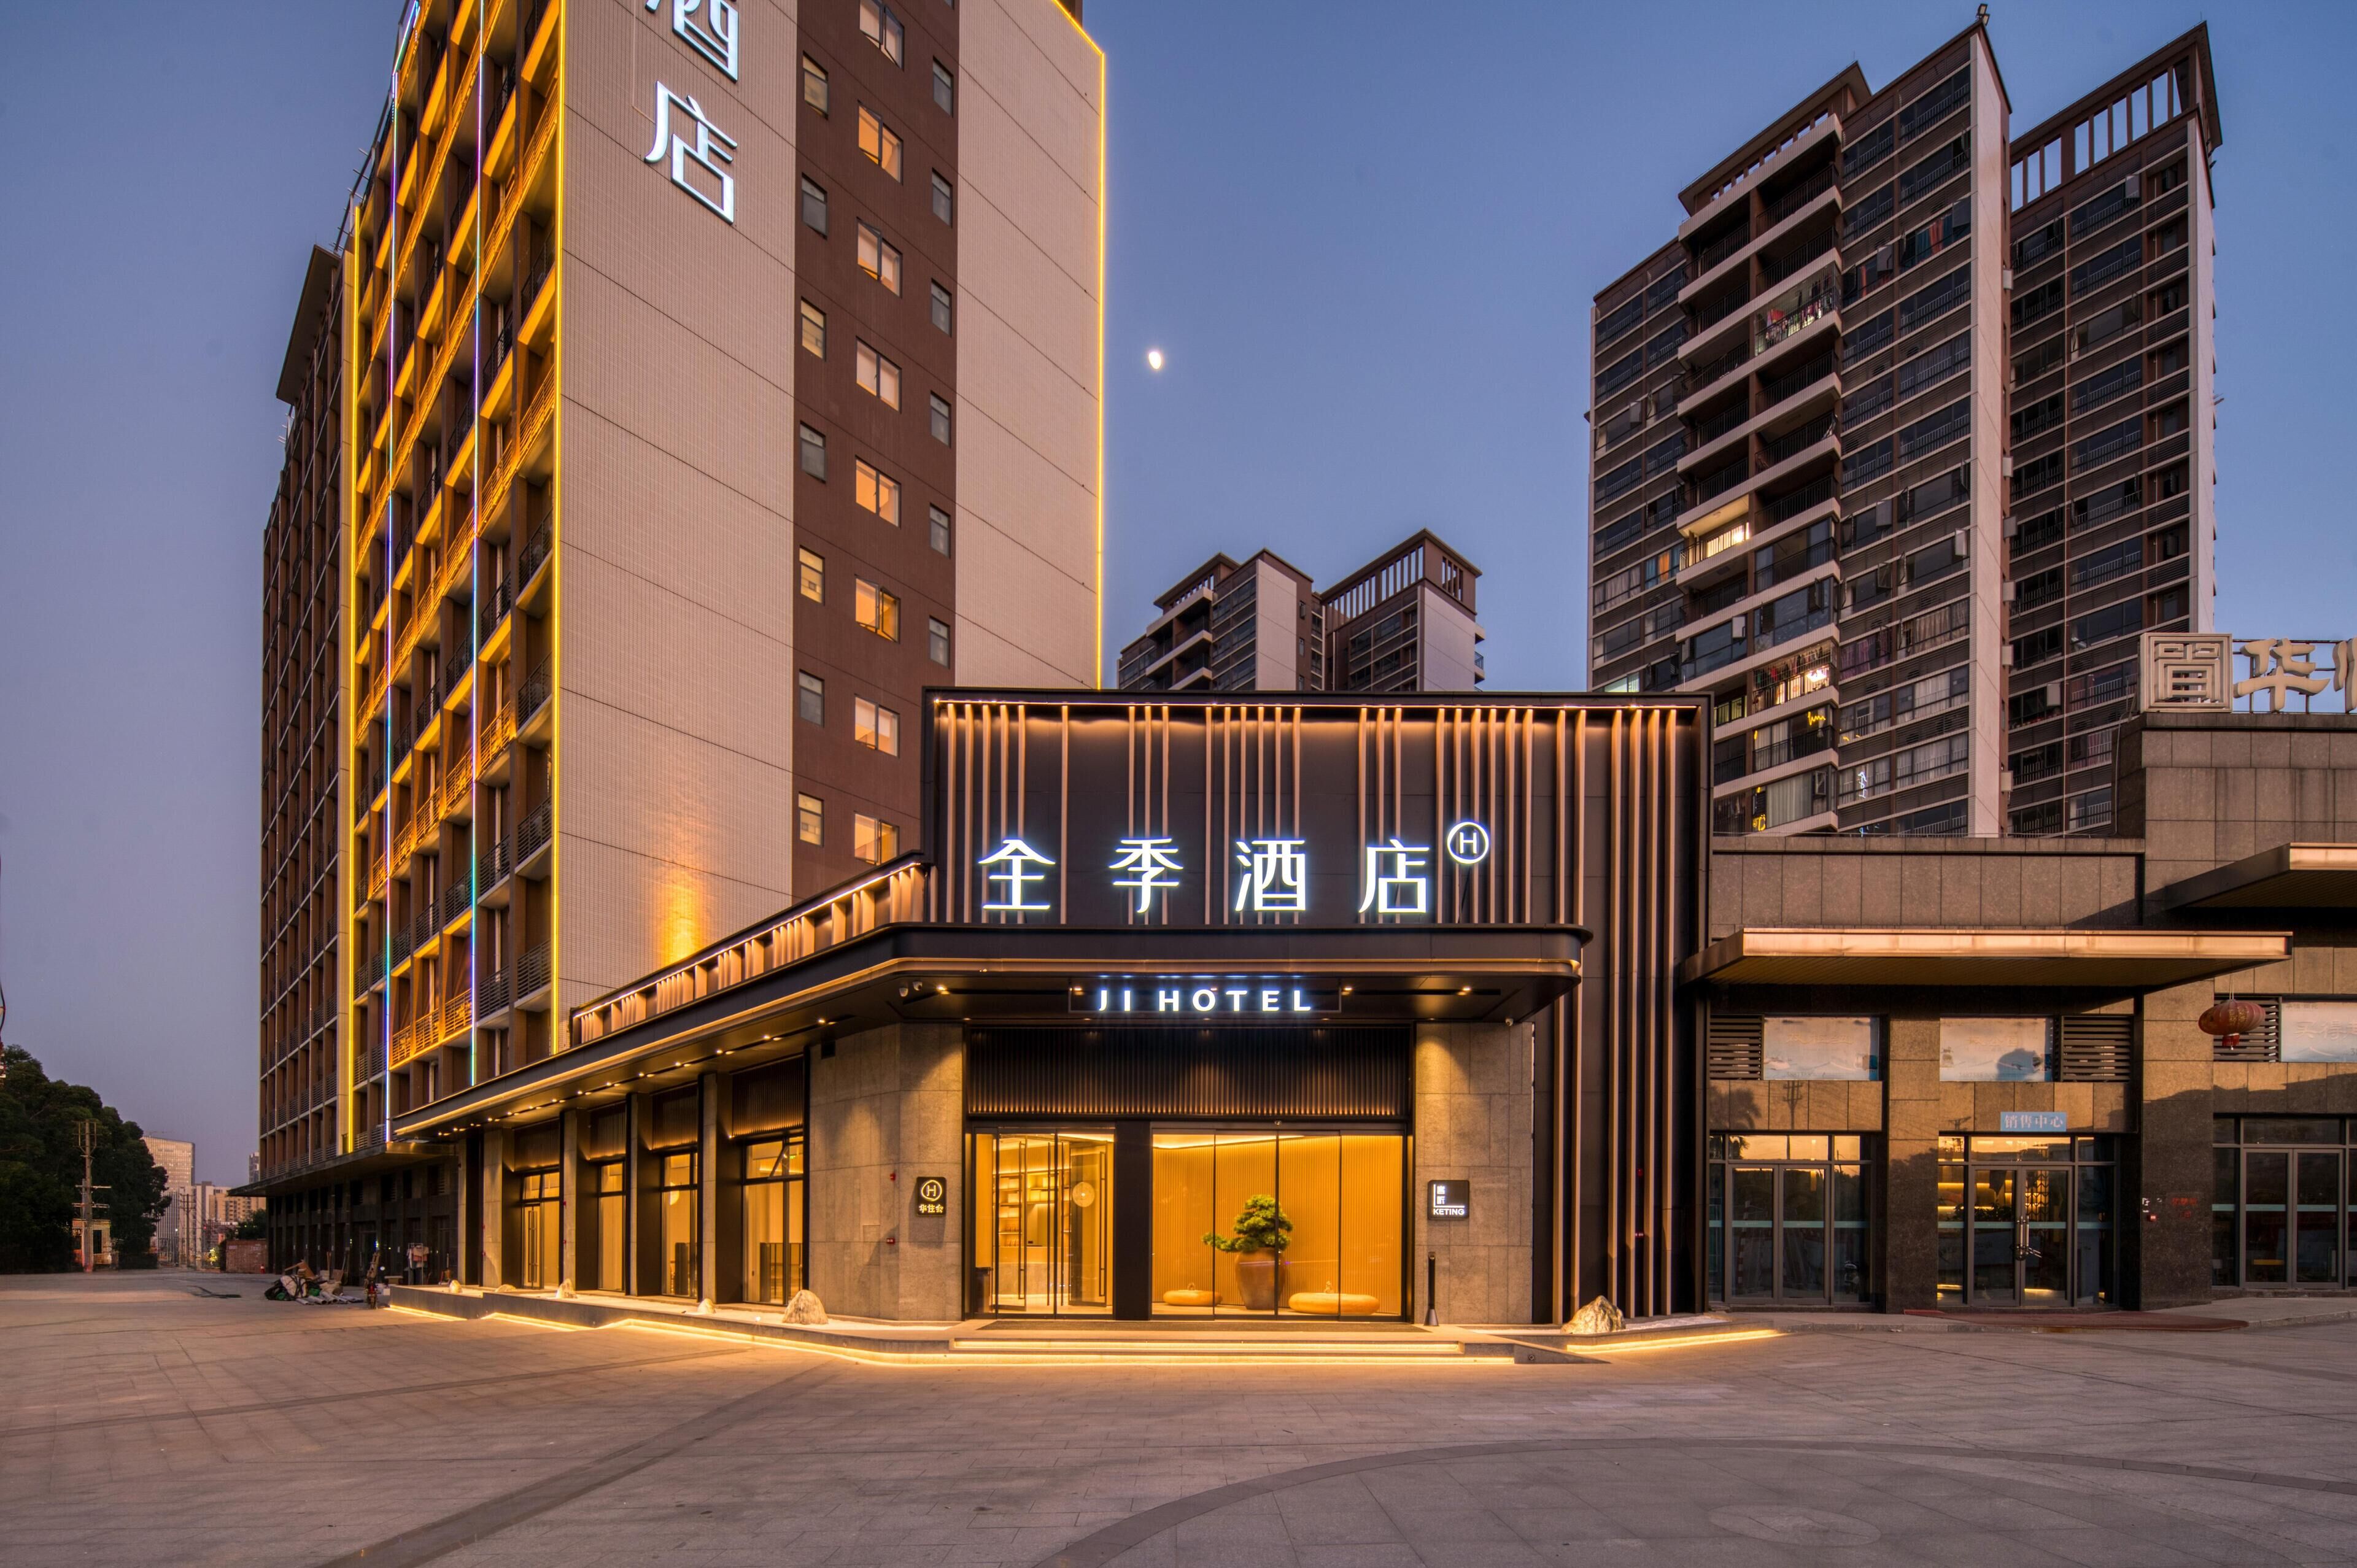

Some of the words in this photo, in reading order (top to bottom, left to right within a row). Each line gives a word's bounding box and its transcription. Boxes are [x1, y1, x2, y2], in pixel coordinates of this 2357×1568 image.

[978, 838, 1430, 913] 全季酒店
[1099, 990, 1131, 1012] JI
[1159, 988, 1312, 1012] HOTEL
[2005, 1114, 2063, 1129] 销售中心
[919, 1204, 943, 1213] 华住会
